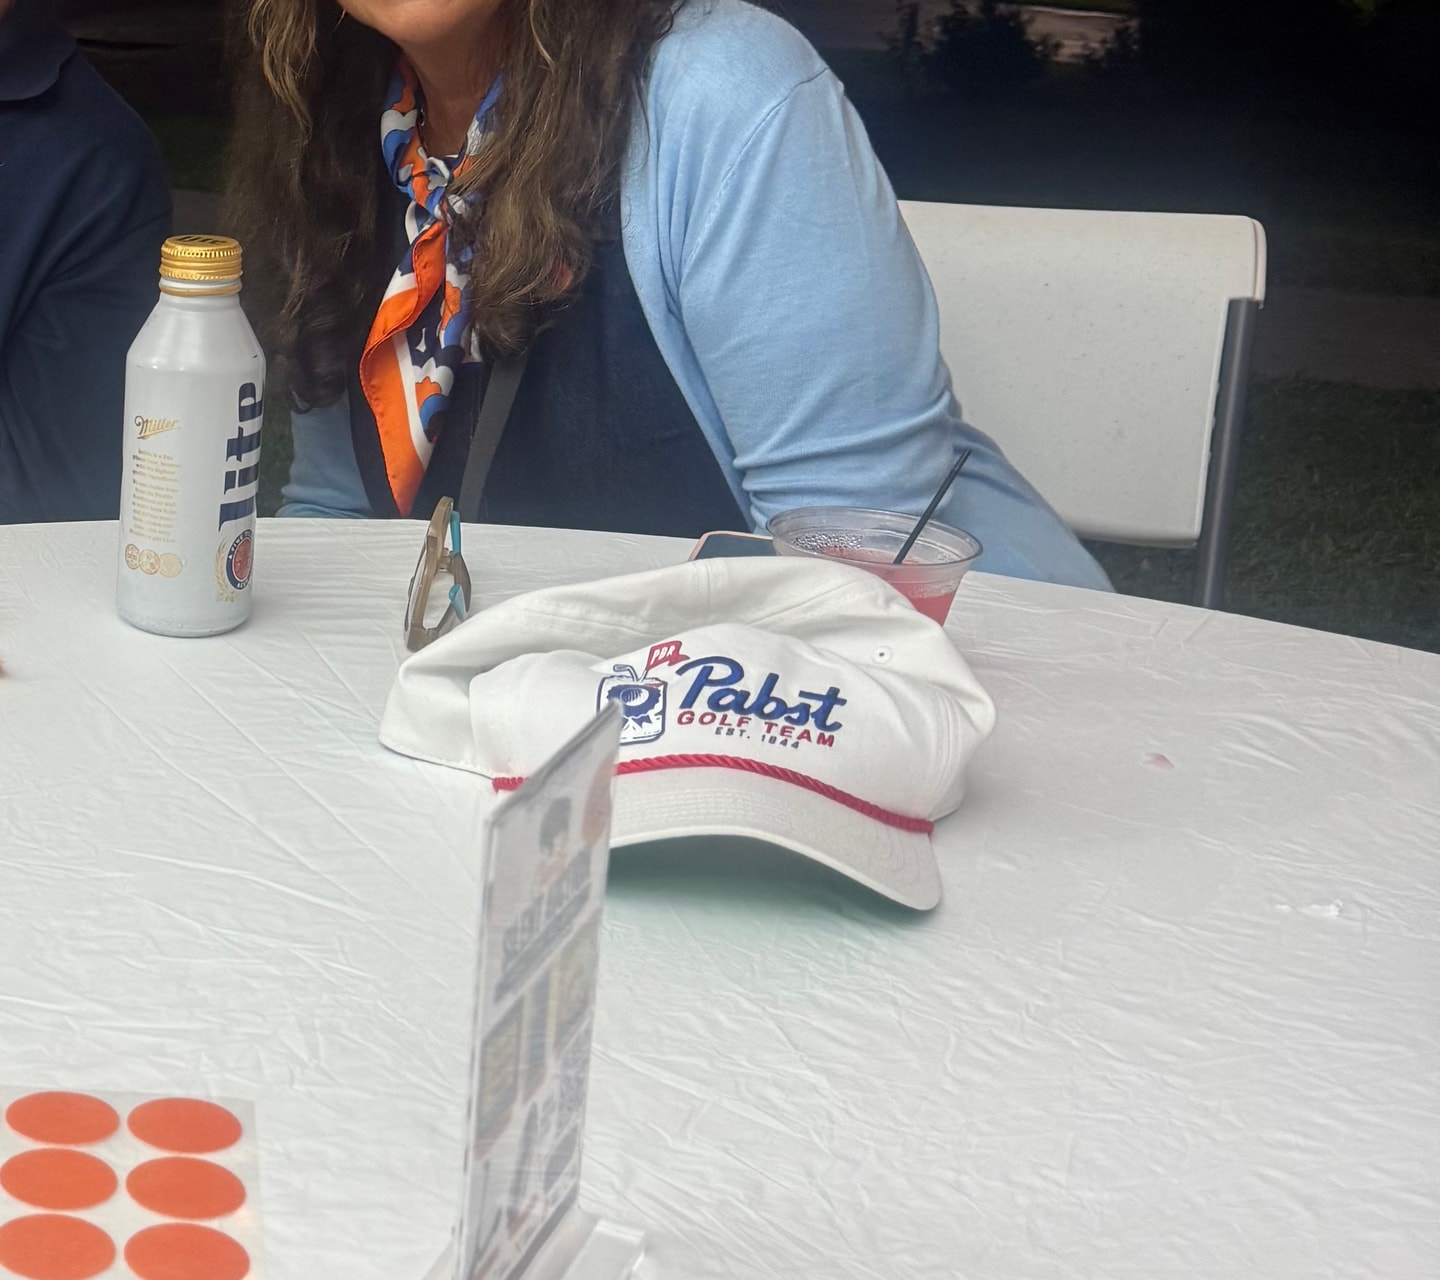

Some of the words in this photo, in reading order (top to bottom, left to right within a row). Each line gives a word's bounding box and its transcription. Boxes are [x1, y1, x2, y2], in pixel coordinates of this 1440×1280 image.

[134, 415, 180, 439] Miller
[649, 645, 677, 666] PBR
[675, 655, 848, 733] Pabst
[676, 710, 752, 728] GOLF
[763, 721, 835, 748] TEAM
[714, 726, 751, 739] EST.
[760, 734, 800, 749] 1844
